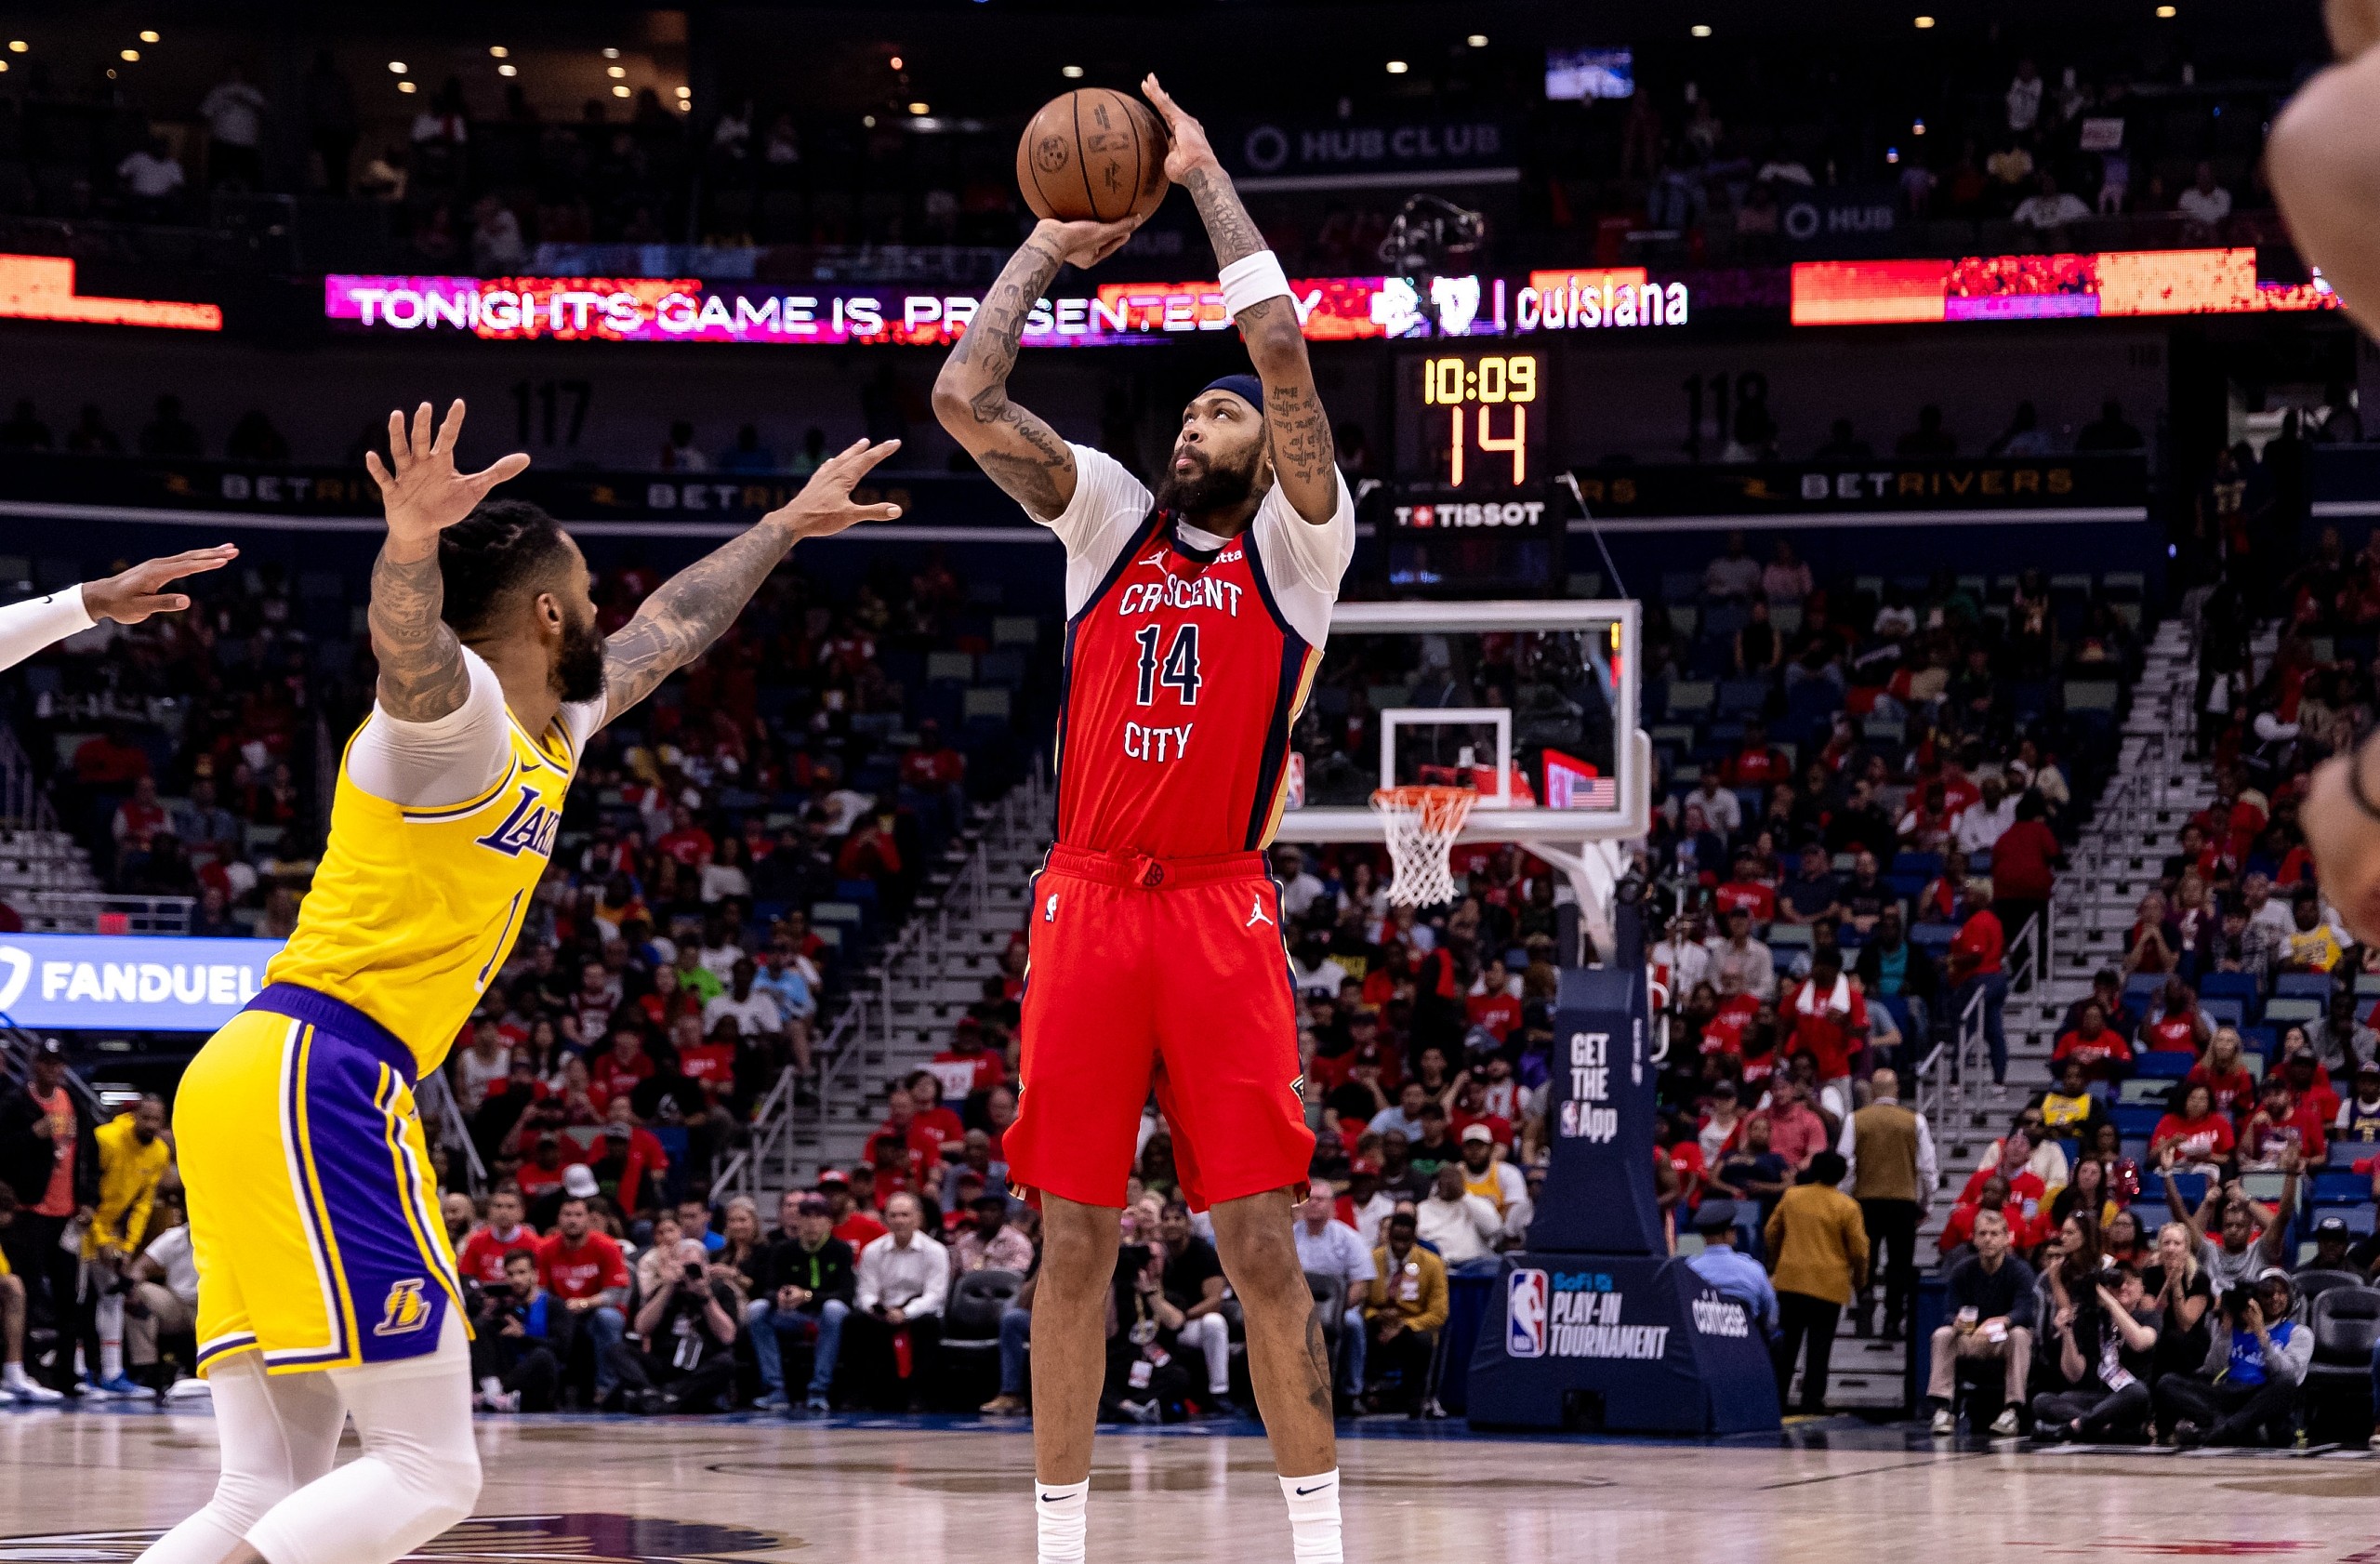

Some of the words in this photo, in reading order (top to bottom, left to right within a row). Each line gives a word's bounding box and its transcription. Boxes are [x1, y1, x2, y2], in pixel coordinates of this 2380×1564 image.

[1303, 127, 1384, 162] HUB
[1391, 124, 1501, 157] CLUB
[656, 292, 818, 334] GAME
[832, 297, 886, 335] IS
[905, 293, 1234, 336] PRSENTED
[1424, 356, 1537, 404] 10:09
[509, 378, 593, 446] 117
[1451, 404, 1526, 487] 14
[1801, 468, 2074, 500] BETRIVERS
[1435, 501, 1545, 528] TISSOT
[1118, 573, 1243, 617] CRSCENT
[1134, 623, 1202, 707] 14
[1124, 721, 1194, 762] CITY
[41, 961, 261, 1005] FANDUEL
[1570, 1032, 1610, 1067] GET
[1569, 1067, 1610, 1101] THE
[1578, 1101, 1618, 1144] App
[1551, 1291, 1623, 1324] PLAY-IN
[1549, 1324, 1671, 1360] TOURNAMENT
